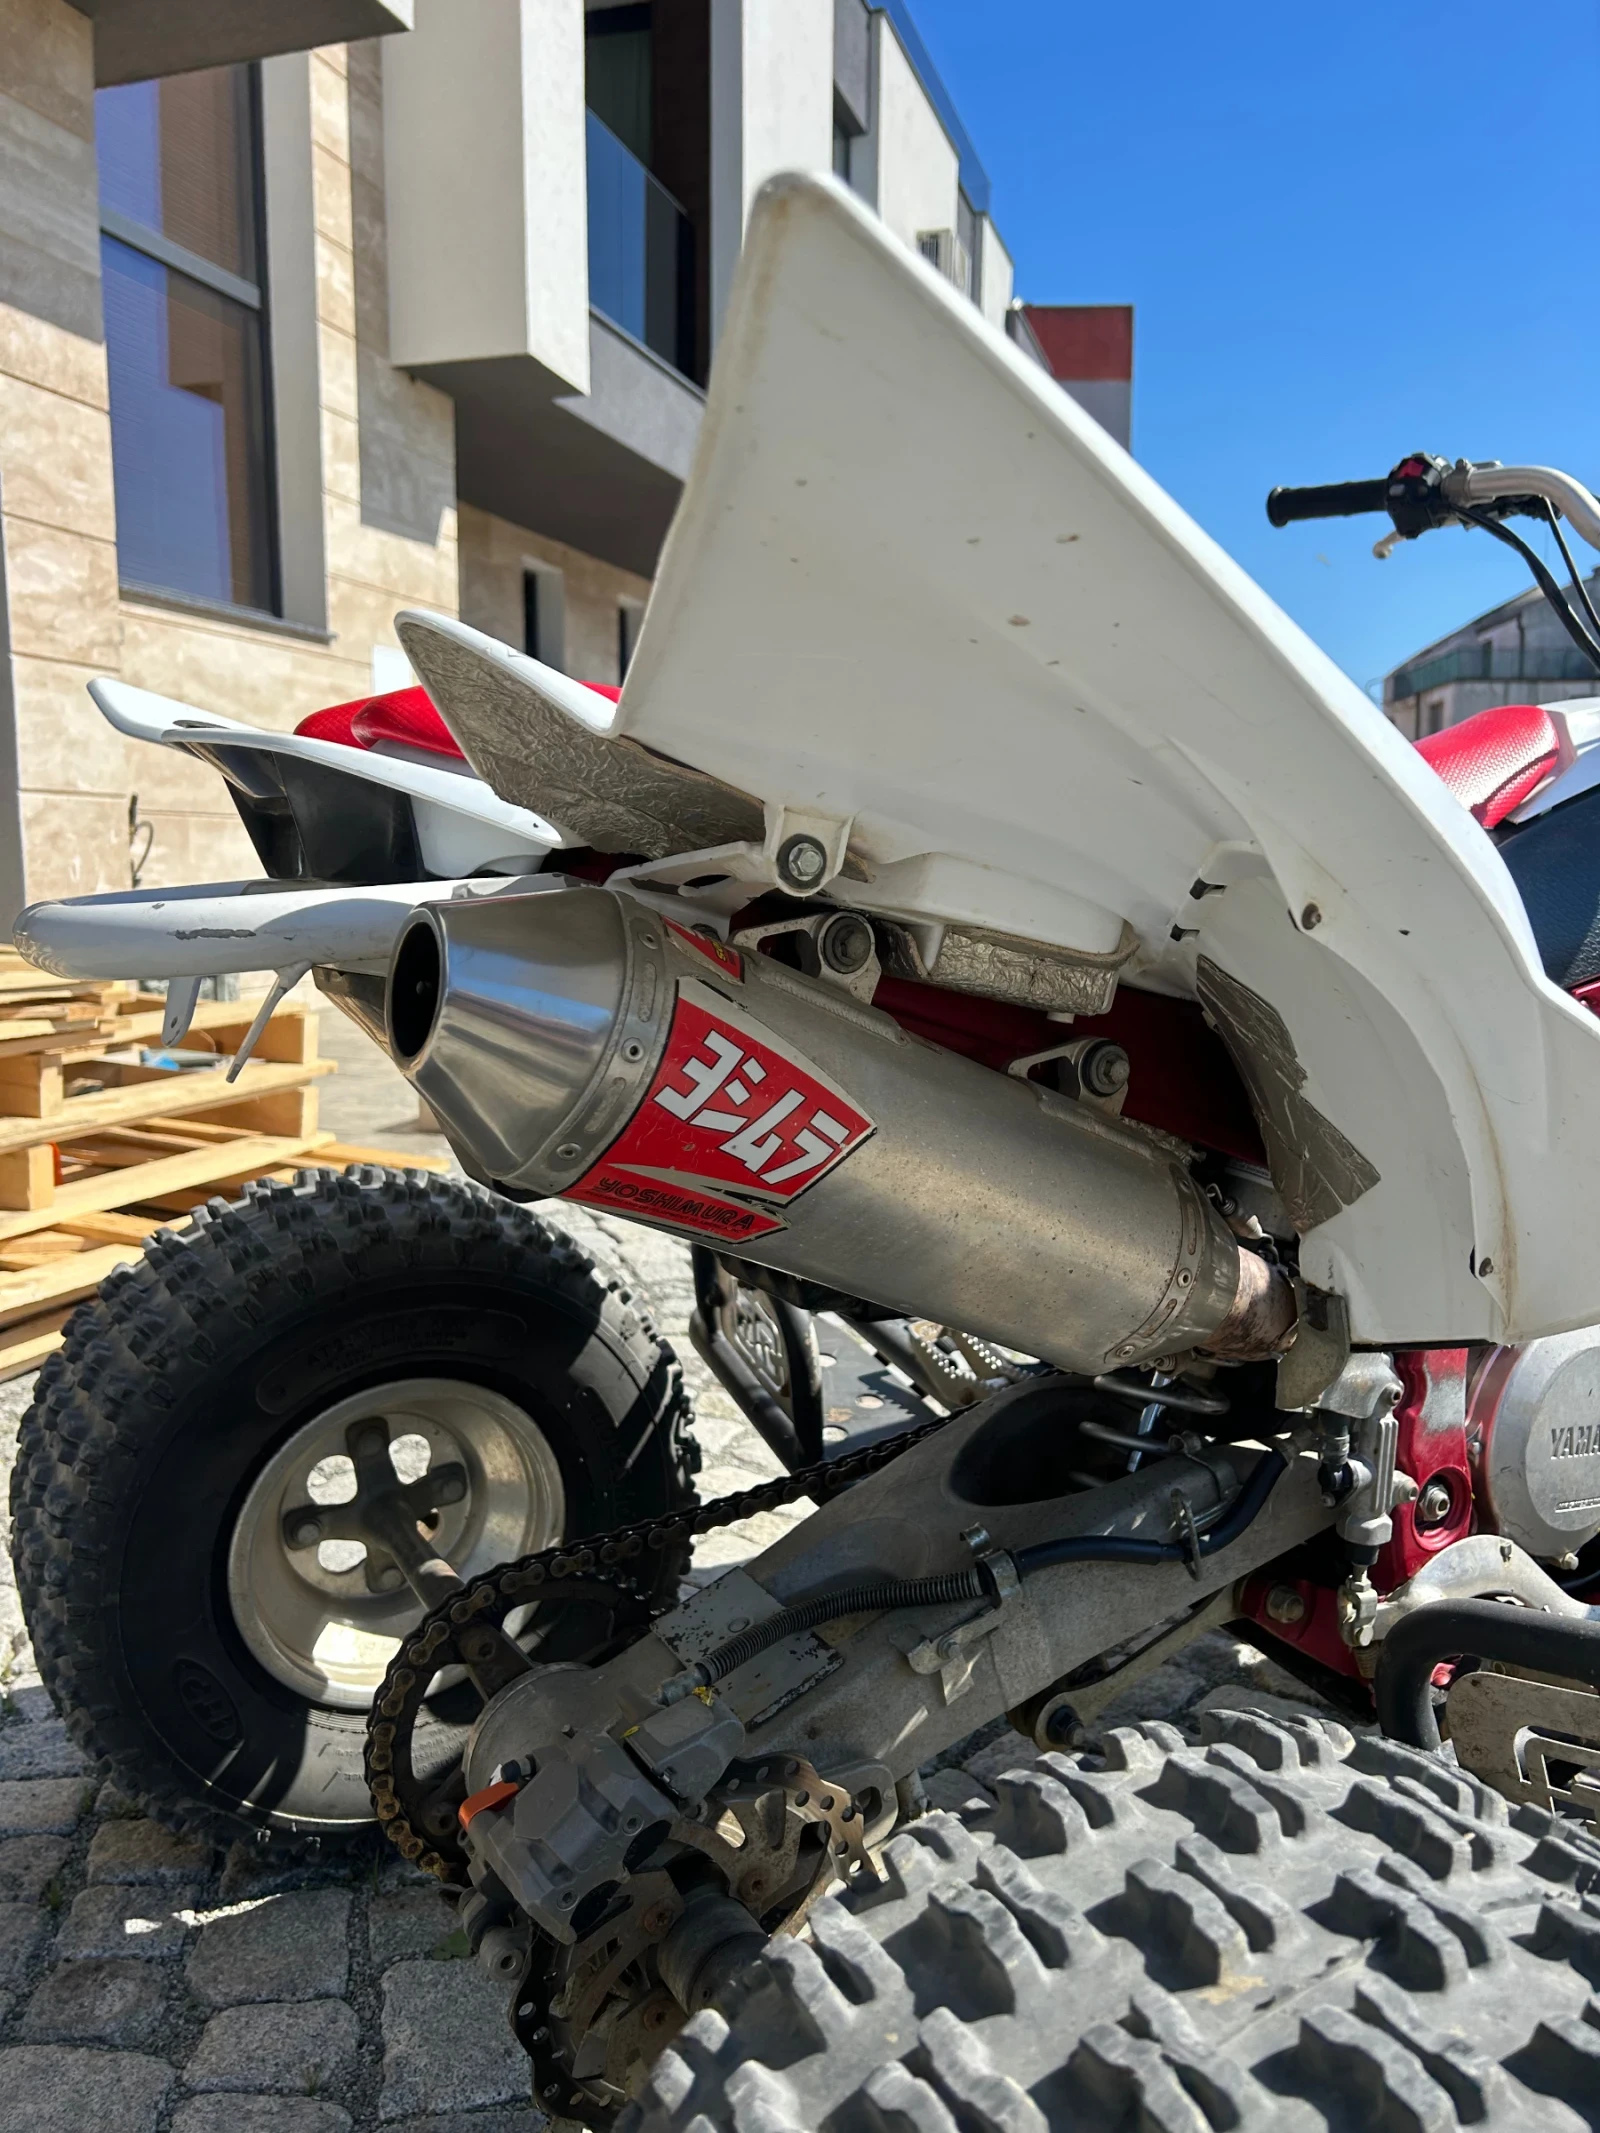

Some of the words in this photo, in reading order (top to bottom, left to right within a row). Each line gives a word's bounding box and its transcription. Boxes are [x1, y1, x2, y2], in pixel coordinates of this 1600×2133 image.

[653, 1028, 851, 1185] ヨシムラ
[593, 1177, 756, 1230] YOSHIMURA
